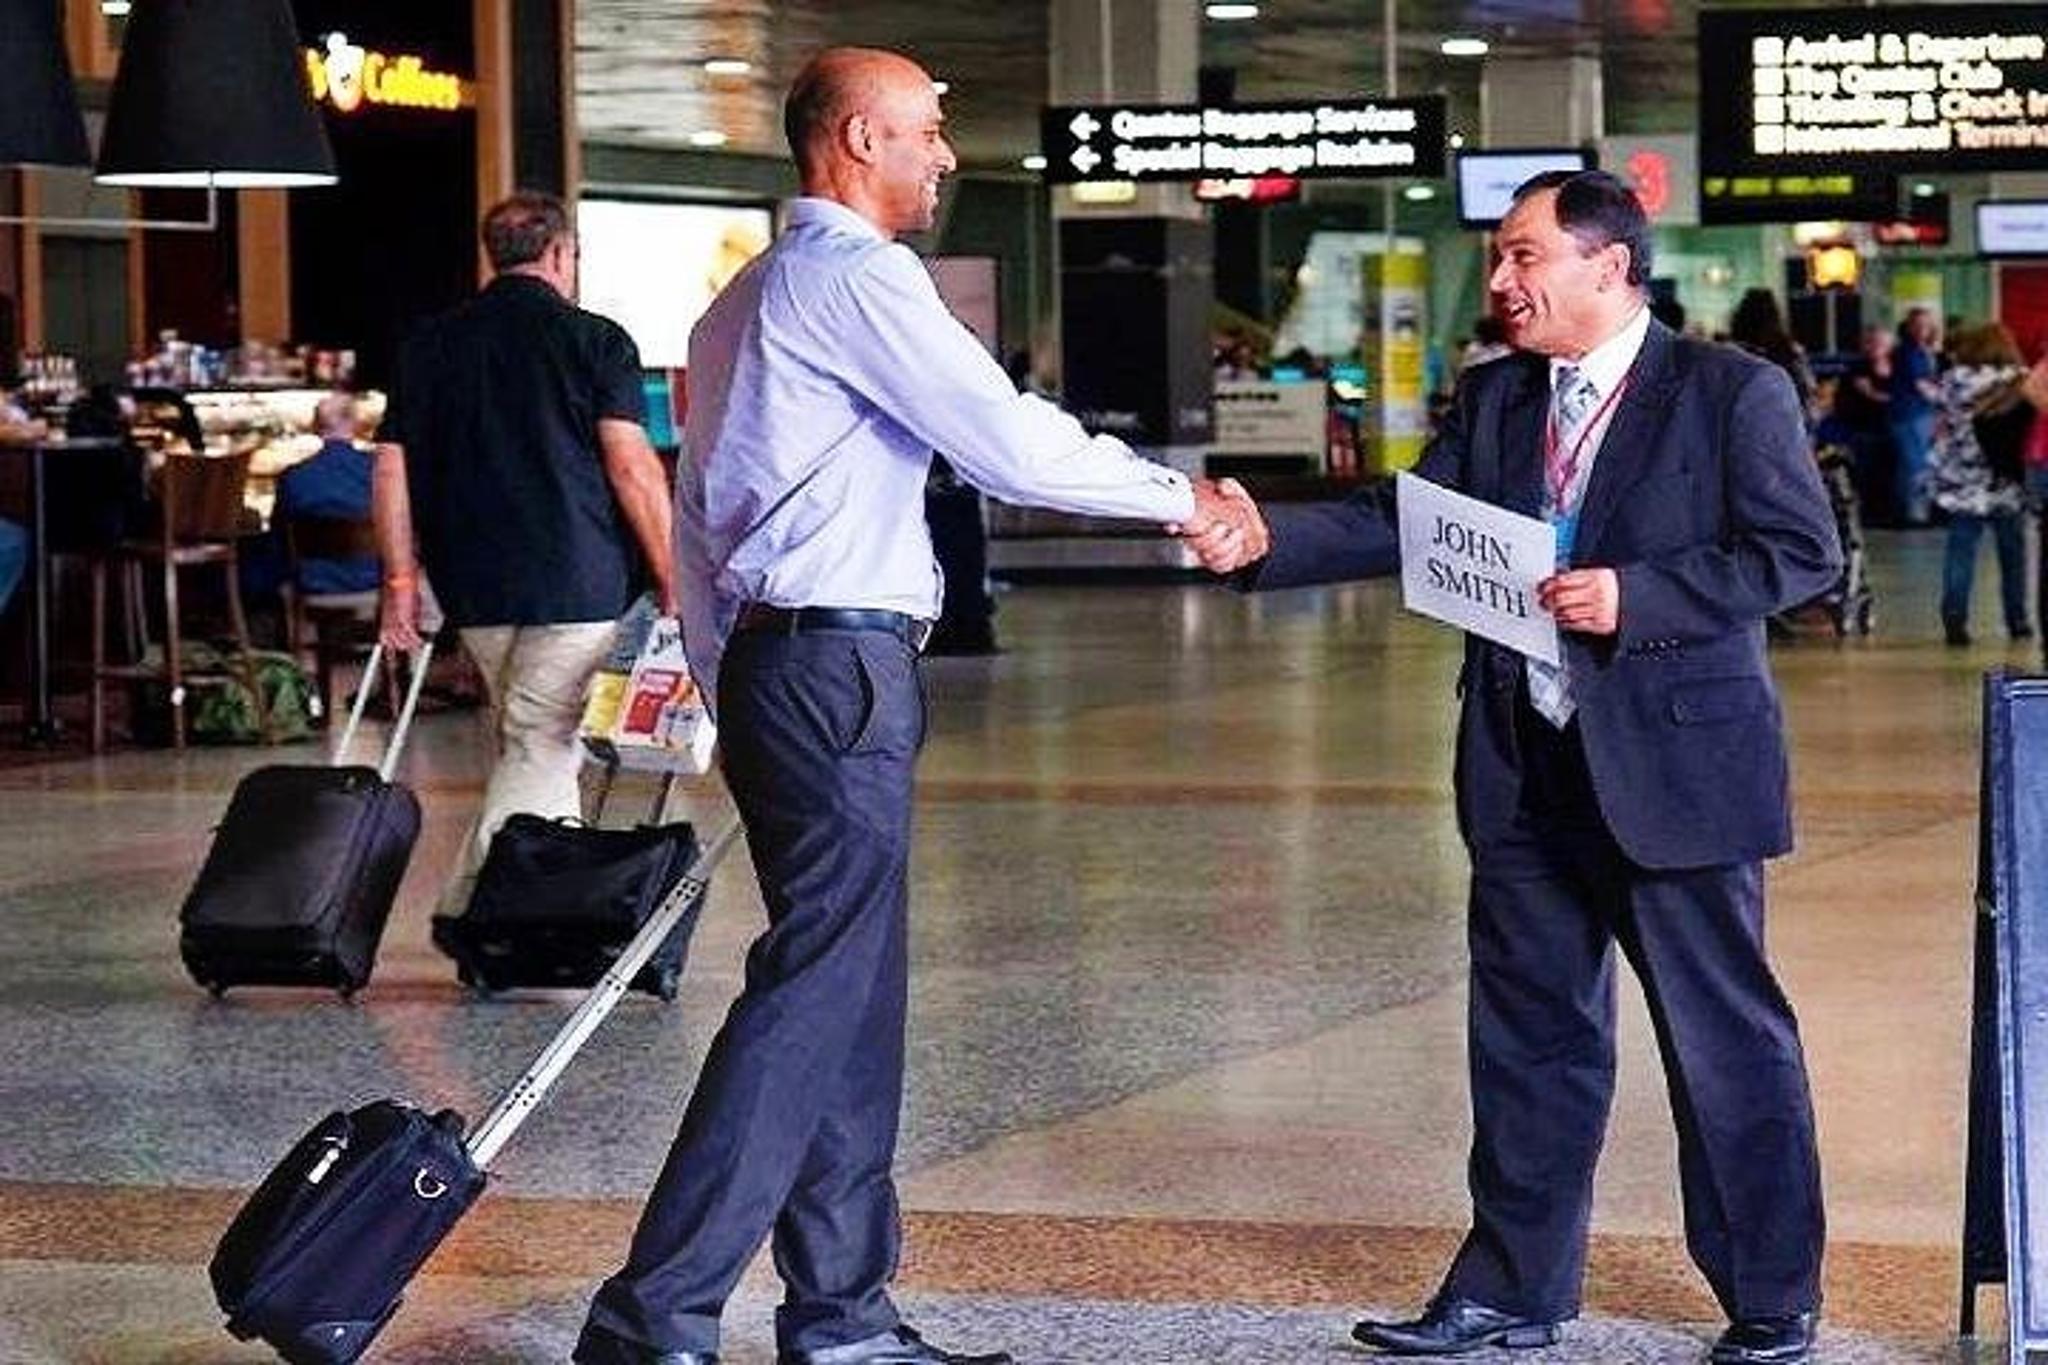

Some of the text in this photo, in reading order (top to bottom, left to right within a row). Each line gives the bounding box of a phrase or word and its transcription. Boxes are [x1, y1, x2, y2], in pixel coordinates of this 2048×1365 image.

[1786, 34, 1875, 64] Arrival
[1880, 34, 1906, 63] &
[1786, 62, 2003, 94] The Qantas Club
[1112, 105, 1416, 141] Qantas Baggage Services
[1786, 92, 1909, 127] Ticketing
[1910, 93, 1936, 121] &
[1939, 89, 2024, 119] Check
[1786, 120, 1951, 153] International
[1113, 138, 1415, 175] Special Baggage Reclaim
[1433, 516, 1511, 571] JOHN
[1427, 557, 1527, 618] SMITH
